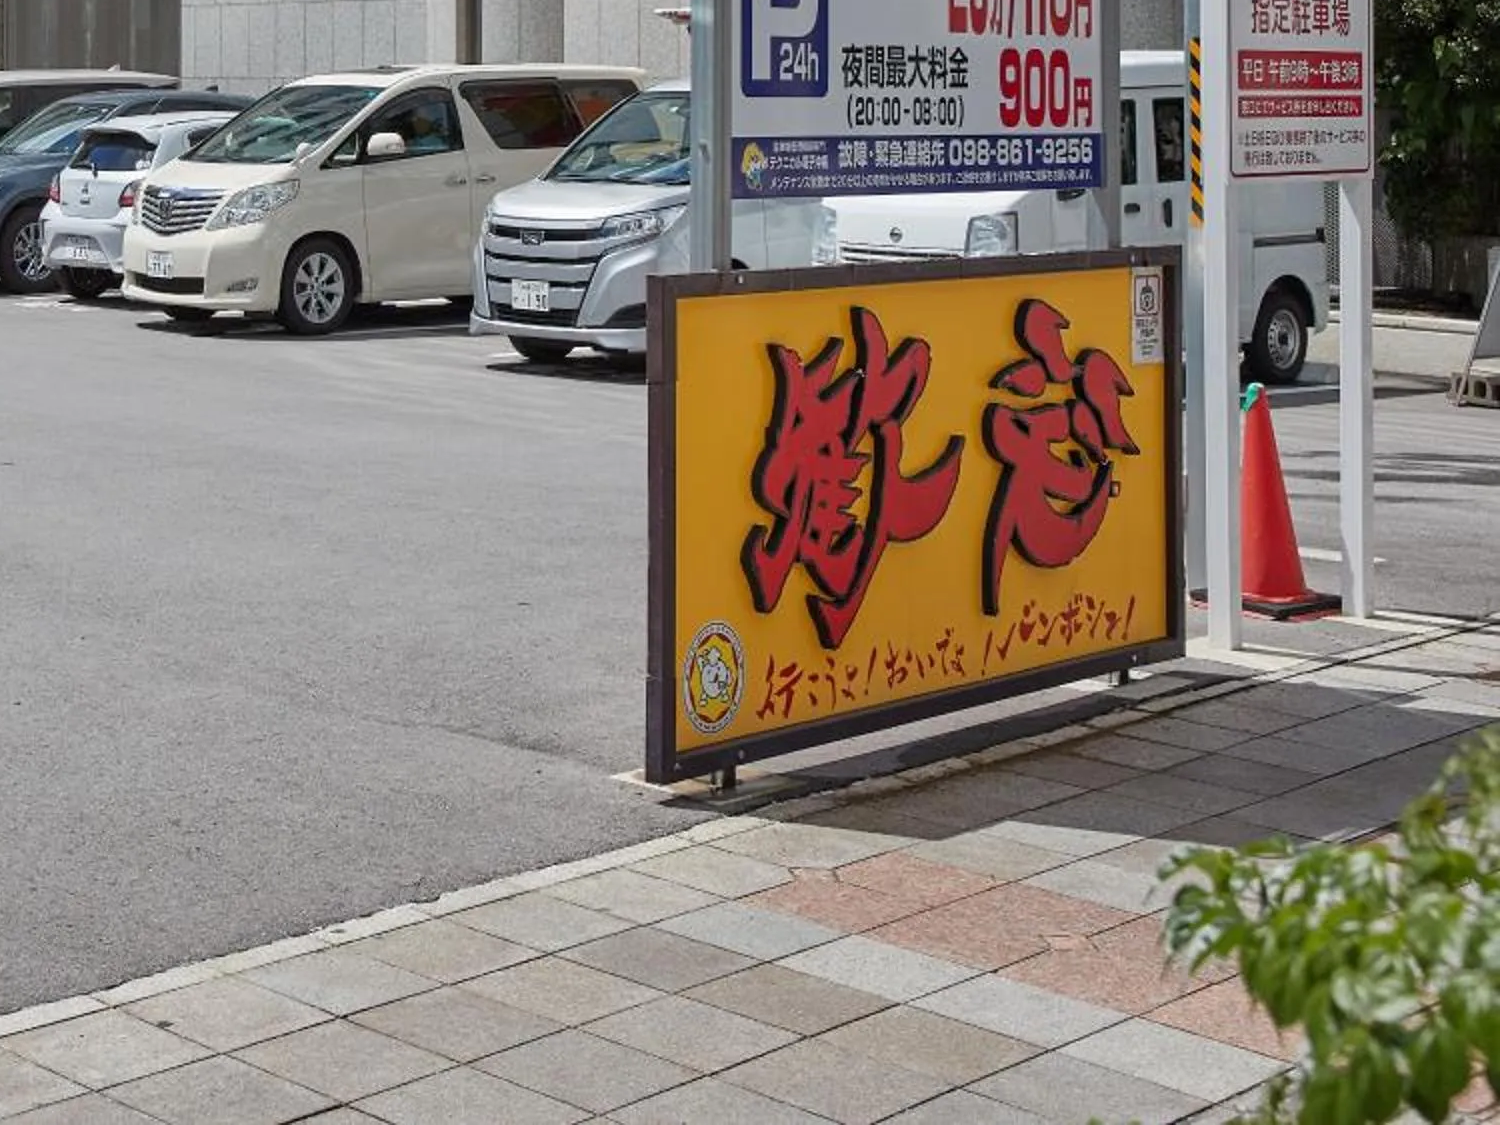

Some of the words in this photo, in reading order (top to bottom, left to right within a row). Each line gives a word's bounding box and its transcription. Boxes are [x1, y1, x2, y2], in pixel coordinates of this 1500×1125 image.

[779, 42, 819, 81] 24h
[841, 45, 969, 89] 夜間最大料金
[1242, 59, 1263, 82] 平日
[999, 48, 1094, 128] 900円
[837, 140, 945, 168] 故障・緊急連絡先
[948, 137, 1093, 166] 098-861-9256
